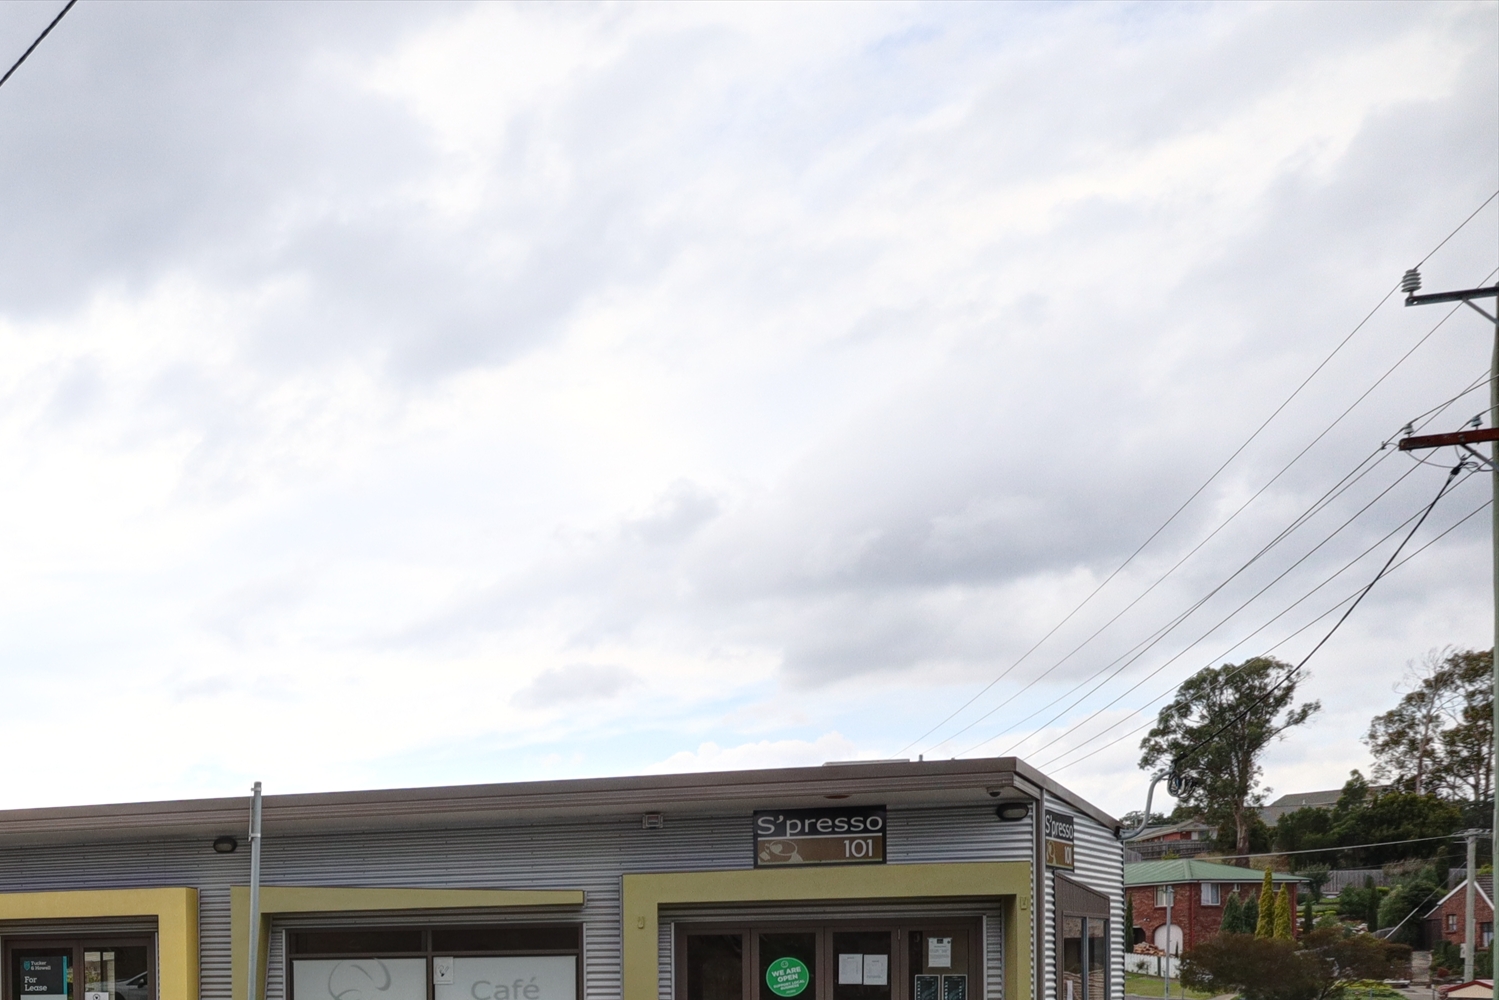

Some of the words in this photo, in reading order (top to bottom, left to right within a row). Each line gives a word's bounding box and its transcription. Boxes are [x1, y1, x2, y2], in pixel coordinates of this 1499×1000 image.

[757, 815, 883, 837] S'presso
[1045, 814, 1074, 839] S'presso
[844, 839, 875, 858] 101
[471, 976, 540, 1000] Café
[778, 974, 798, 982] OPEN
